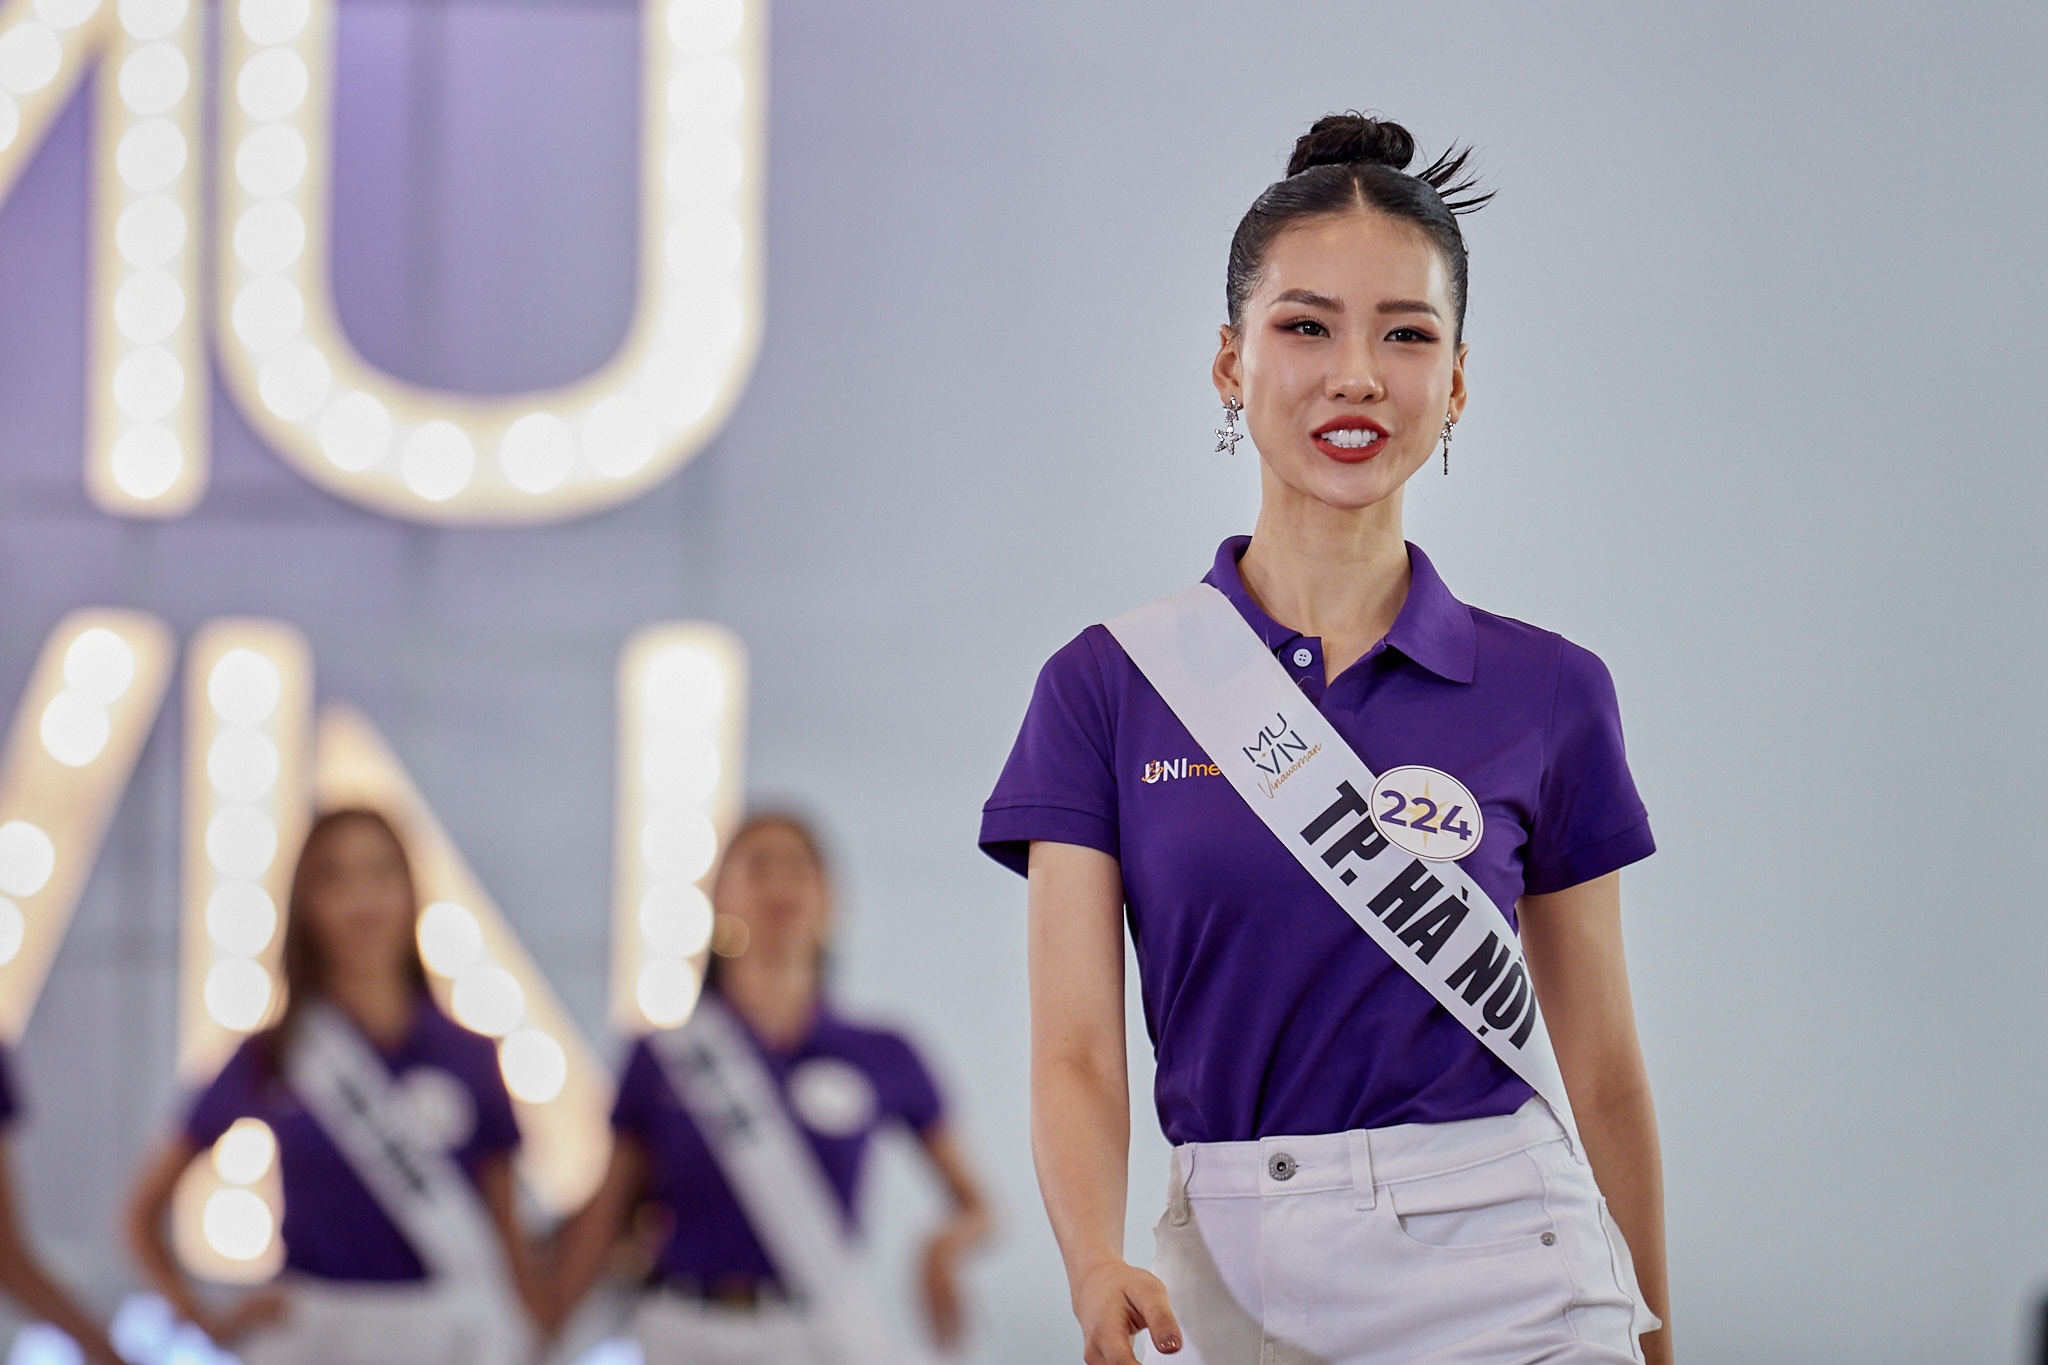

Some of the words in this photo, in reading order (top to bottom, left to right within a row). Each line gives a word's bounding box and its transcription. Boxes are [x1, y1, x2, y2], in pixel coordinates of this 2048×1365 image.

[1242, 712, 1287, 763] MU
[1258, 742, 1322, 799] Vinawoman
[1379, 790, 1472, 841] 224
[1300, 780, 1389, 886] TP.
[1366, 858, 1470, 965] HÀ
[1445, 930, 1536, 1050] NỘI
